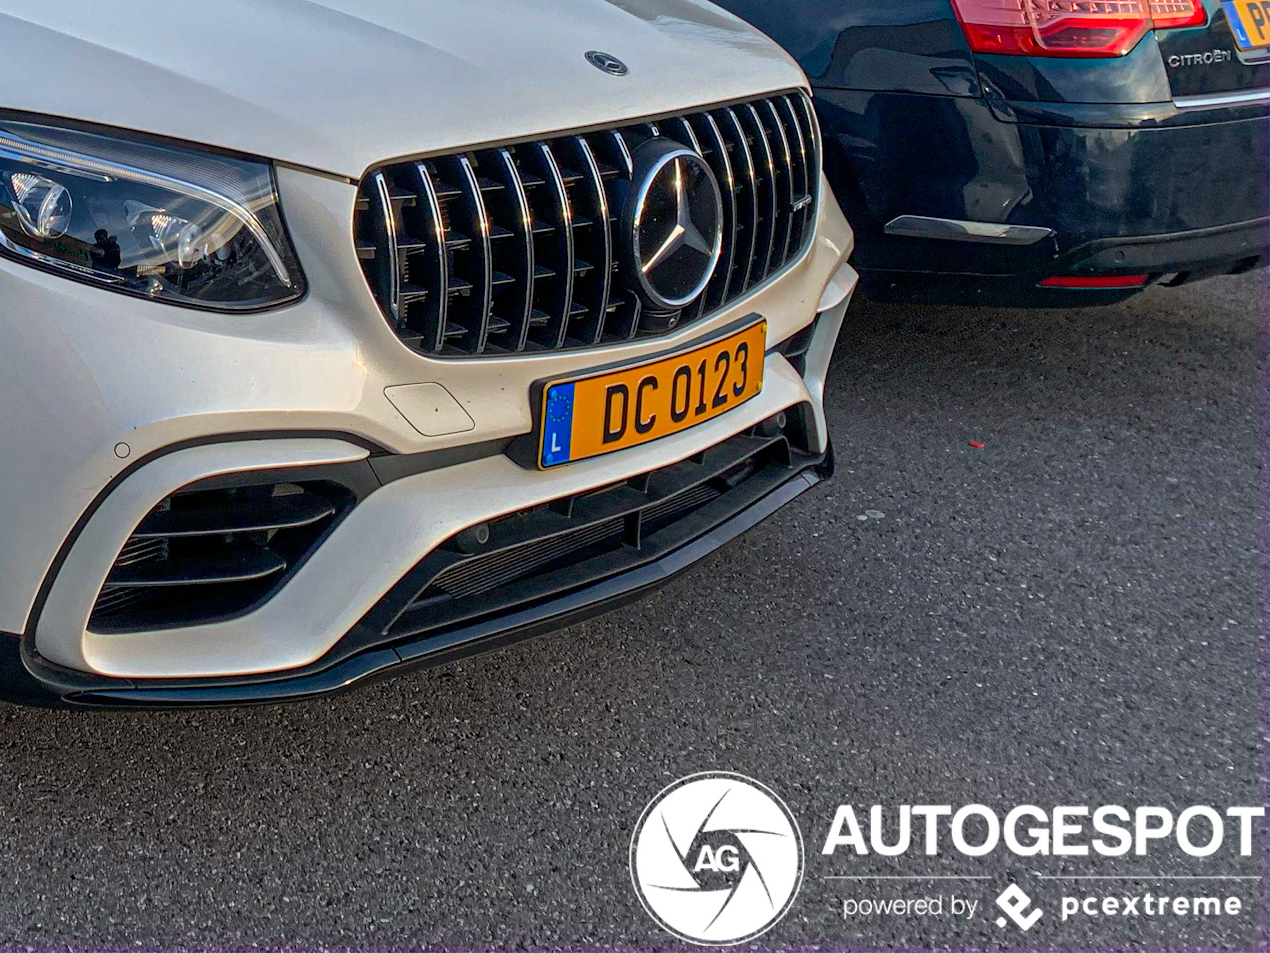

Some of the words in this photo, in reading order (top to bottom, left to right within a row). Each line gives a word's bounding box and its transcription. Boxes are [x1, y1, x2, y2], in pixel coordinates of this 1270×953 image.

[1236, 28, 1246, 41] L
[1168, 49, 1232, 68] CITROËN
[602, 375, 658, 445] DC
[670, 341, 749, 424] 0123
[551, 432, 561, 453] L
